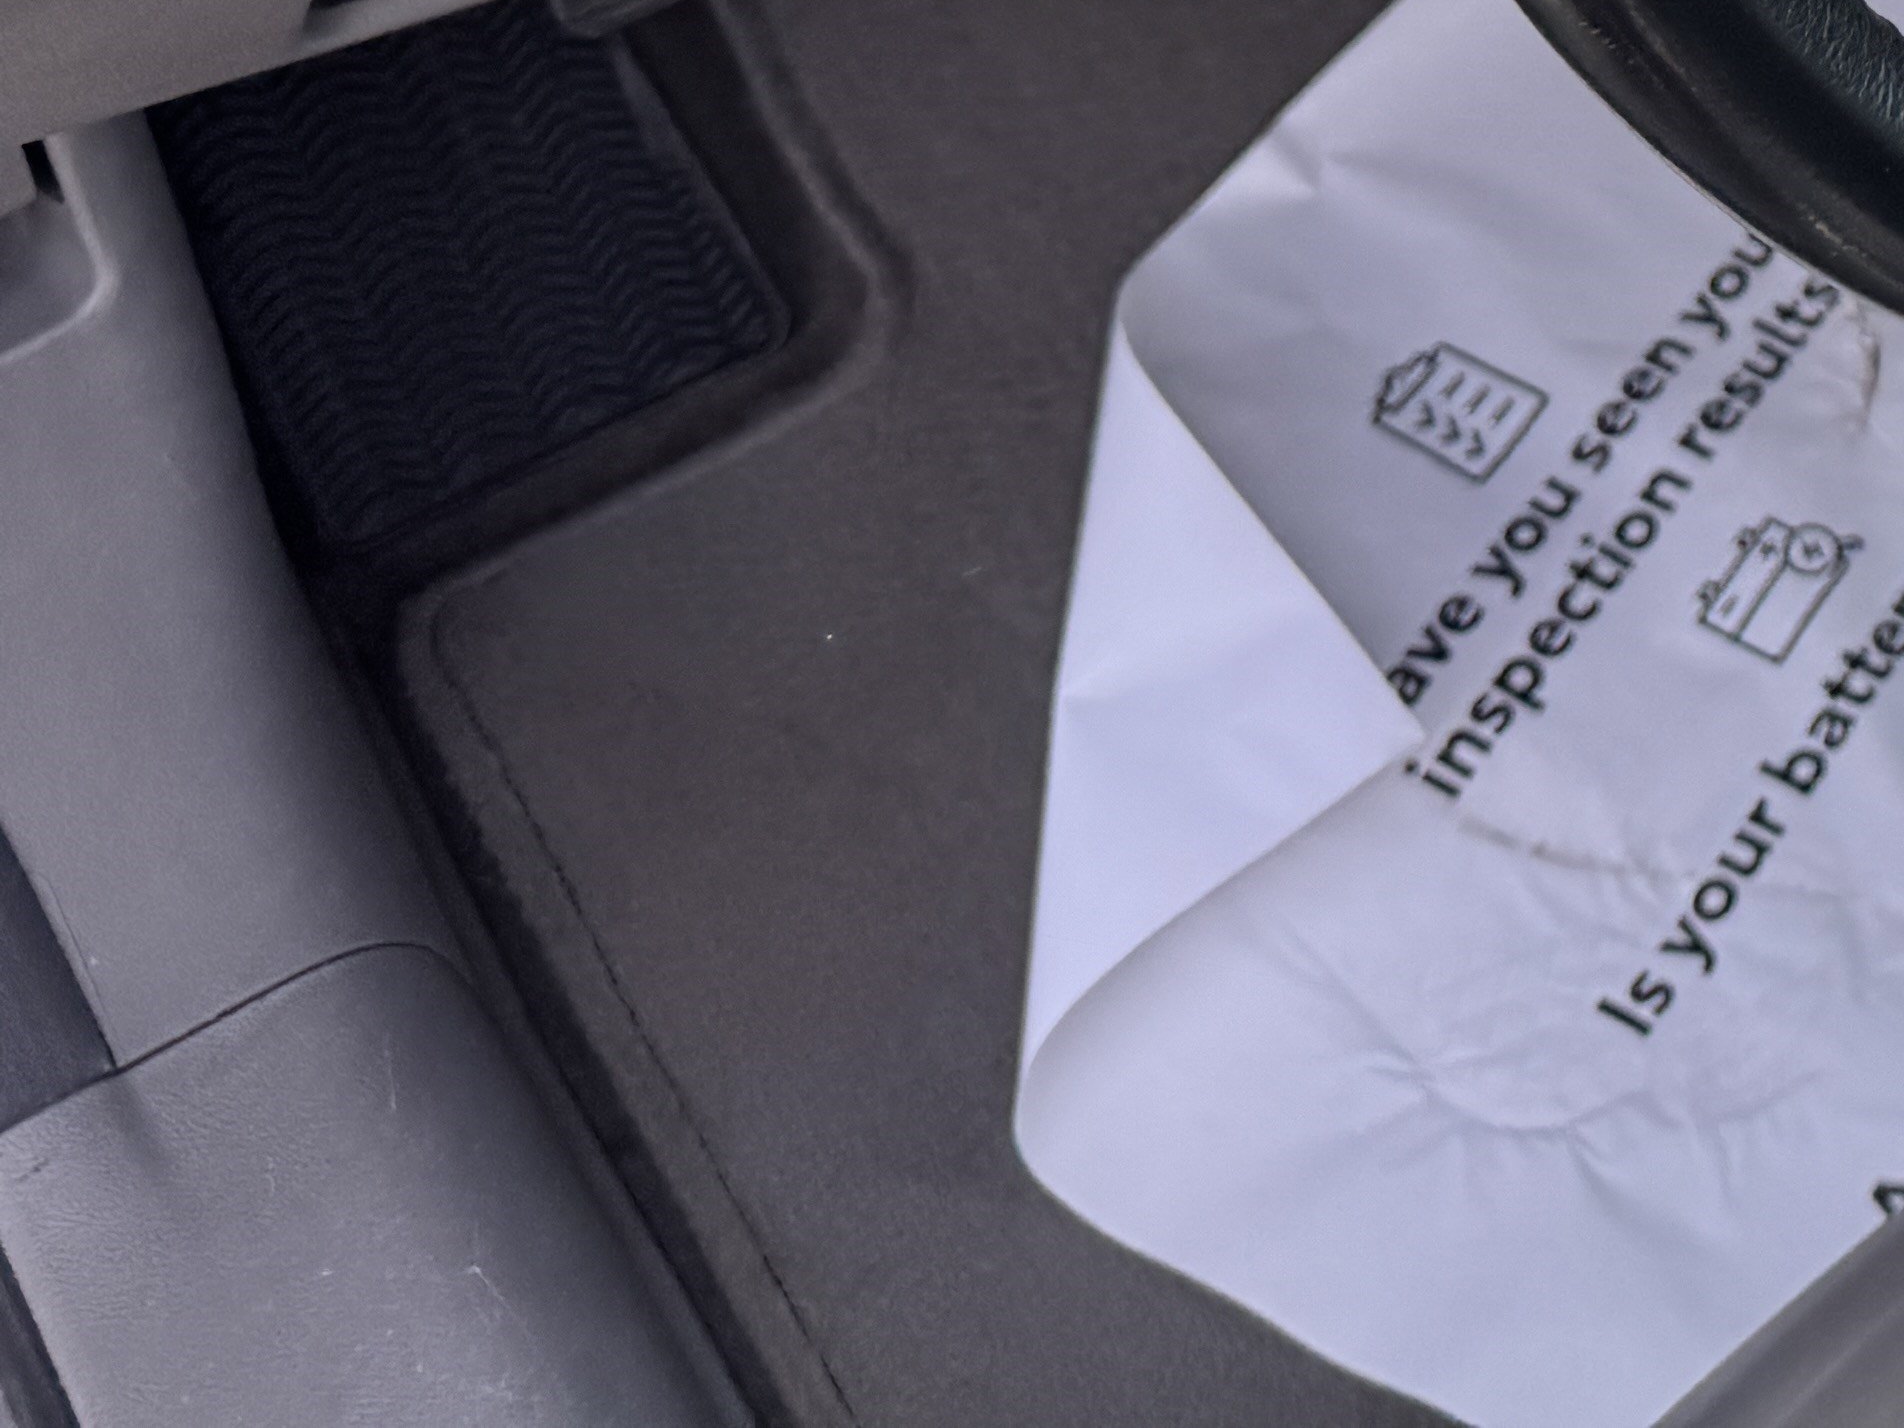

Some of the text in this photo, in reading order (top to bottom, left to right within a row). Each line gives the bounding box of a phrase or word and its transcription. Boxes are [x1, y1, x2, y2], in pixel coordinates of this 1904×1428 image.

[1403, 277, 1842, 799] inspection results
[1471, 476, 1583, 599] you
[1571, 337, 1696, 474] seen
[1596, 969, 1676, 1037] Is
[1658, 796, 1787, 976] your
